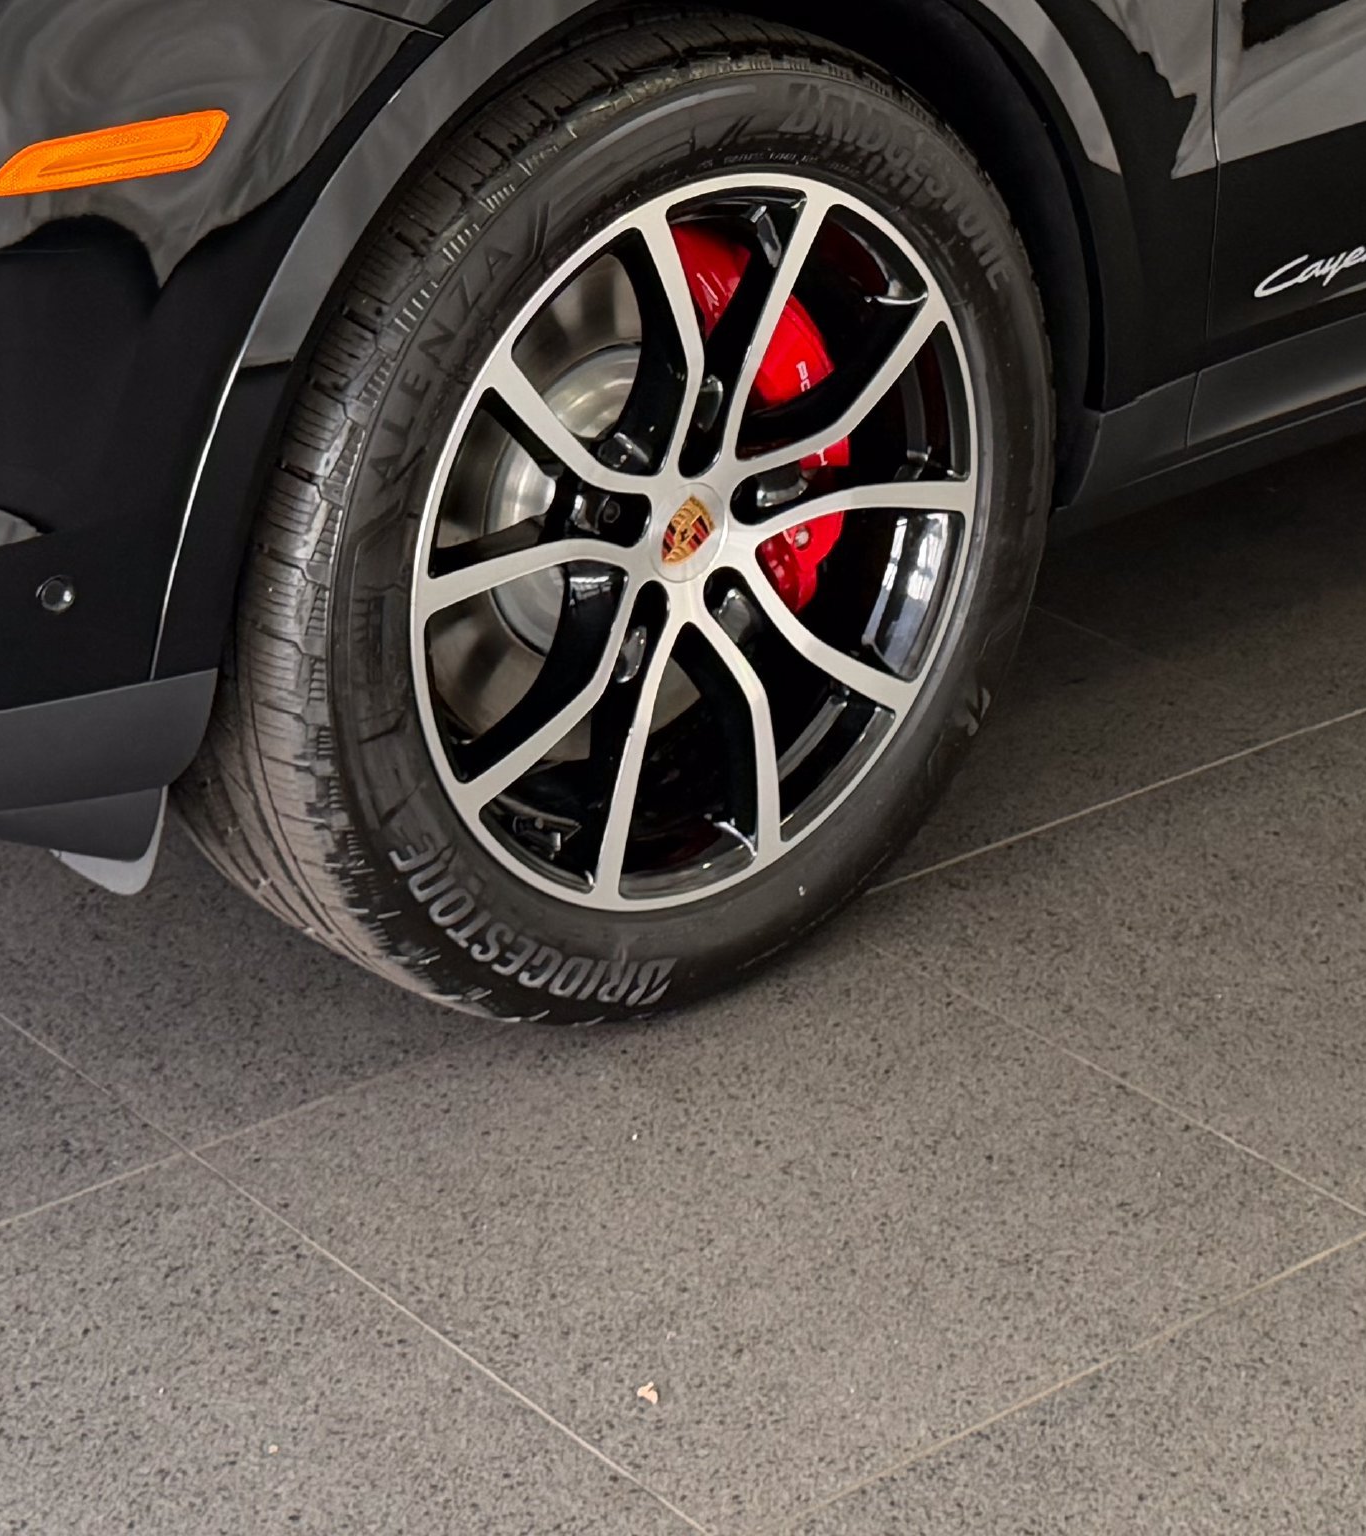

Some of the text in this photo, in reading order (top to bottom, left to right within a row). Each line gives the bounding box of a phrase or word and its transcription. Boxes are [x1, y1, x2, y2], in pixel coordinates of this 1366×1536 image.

[777, 83, 1011, 291] BRIDGESTONE
[368, 246, 514, 494] ALENZA
[387, 834, 679, 1008] BRIDGESTONE
